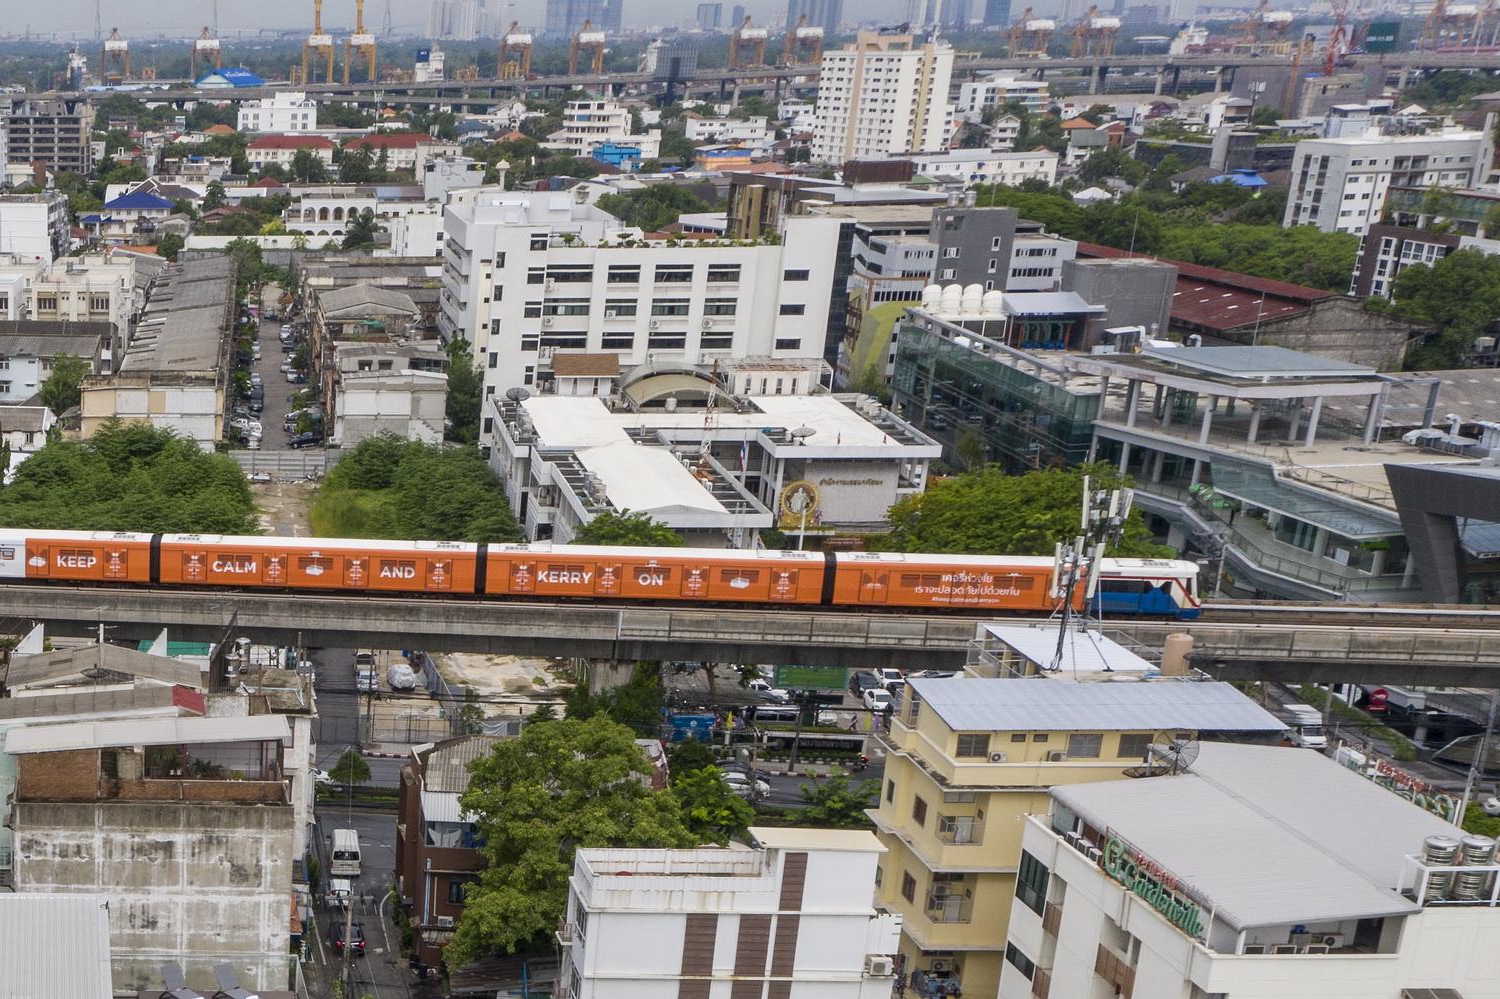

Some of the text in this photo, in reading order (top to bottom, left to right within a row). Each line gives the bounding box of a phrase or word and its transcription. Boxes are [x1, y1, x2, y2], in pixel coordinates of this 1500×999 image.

[56, 555, 97, 568] KEEP
[212, 560, 257, 574] CALM
[380, 566, 415, 579] AND
[537, 570, 593, 584] KERRY
[638, 574, 664, 586] ON
